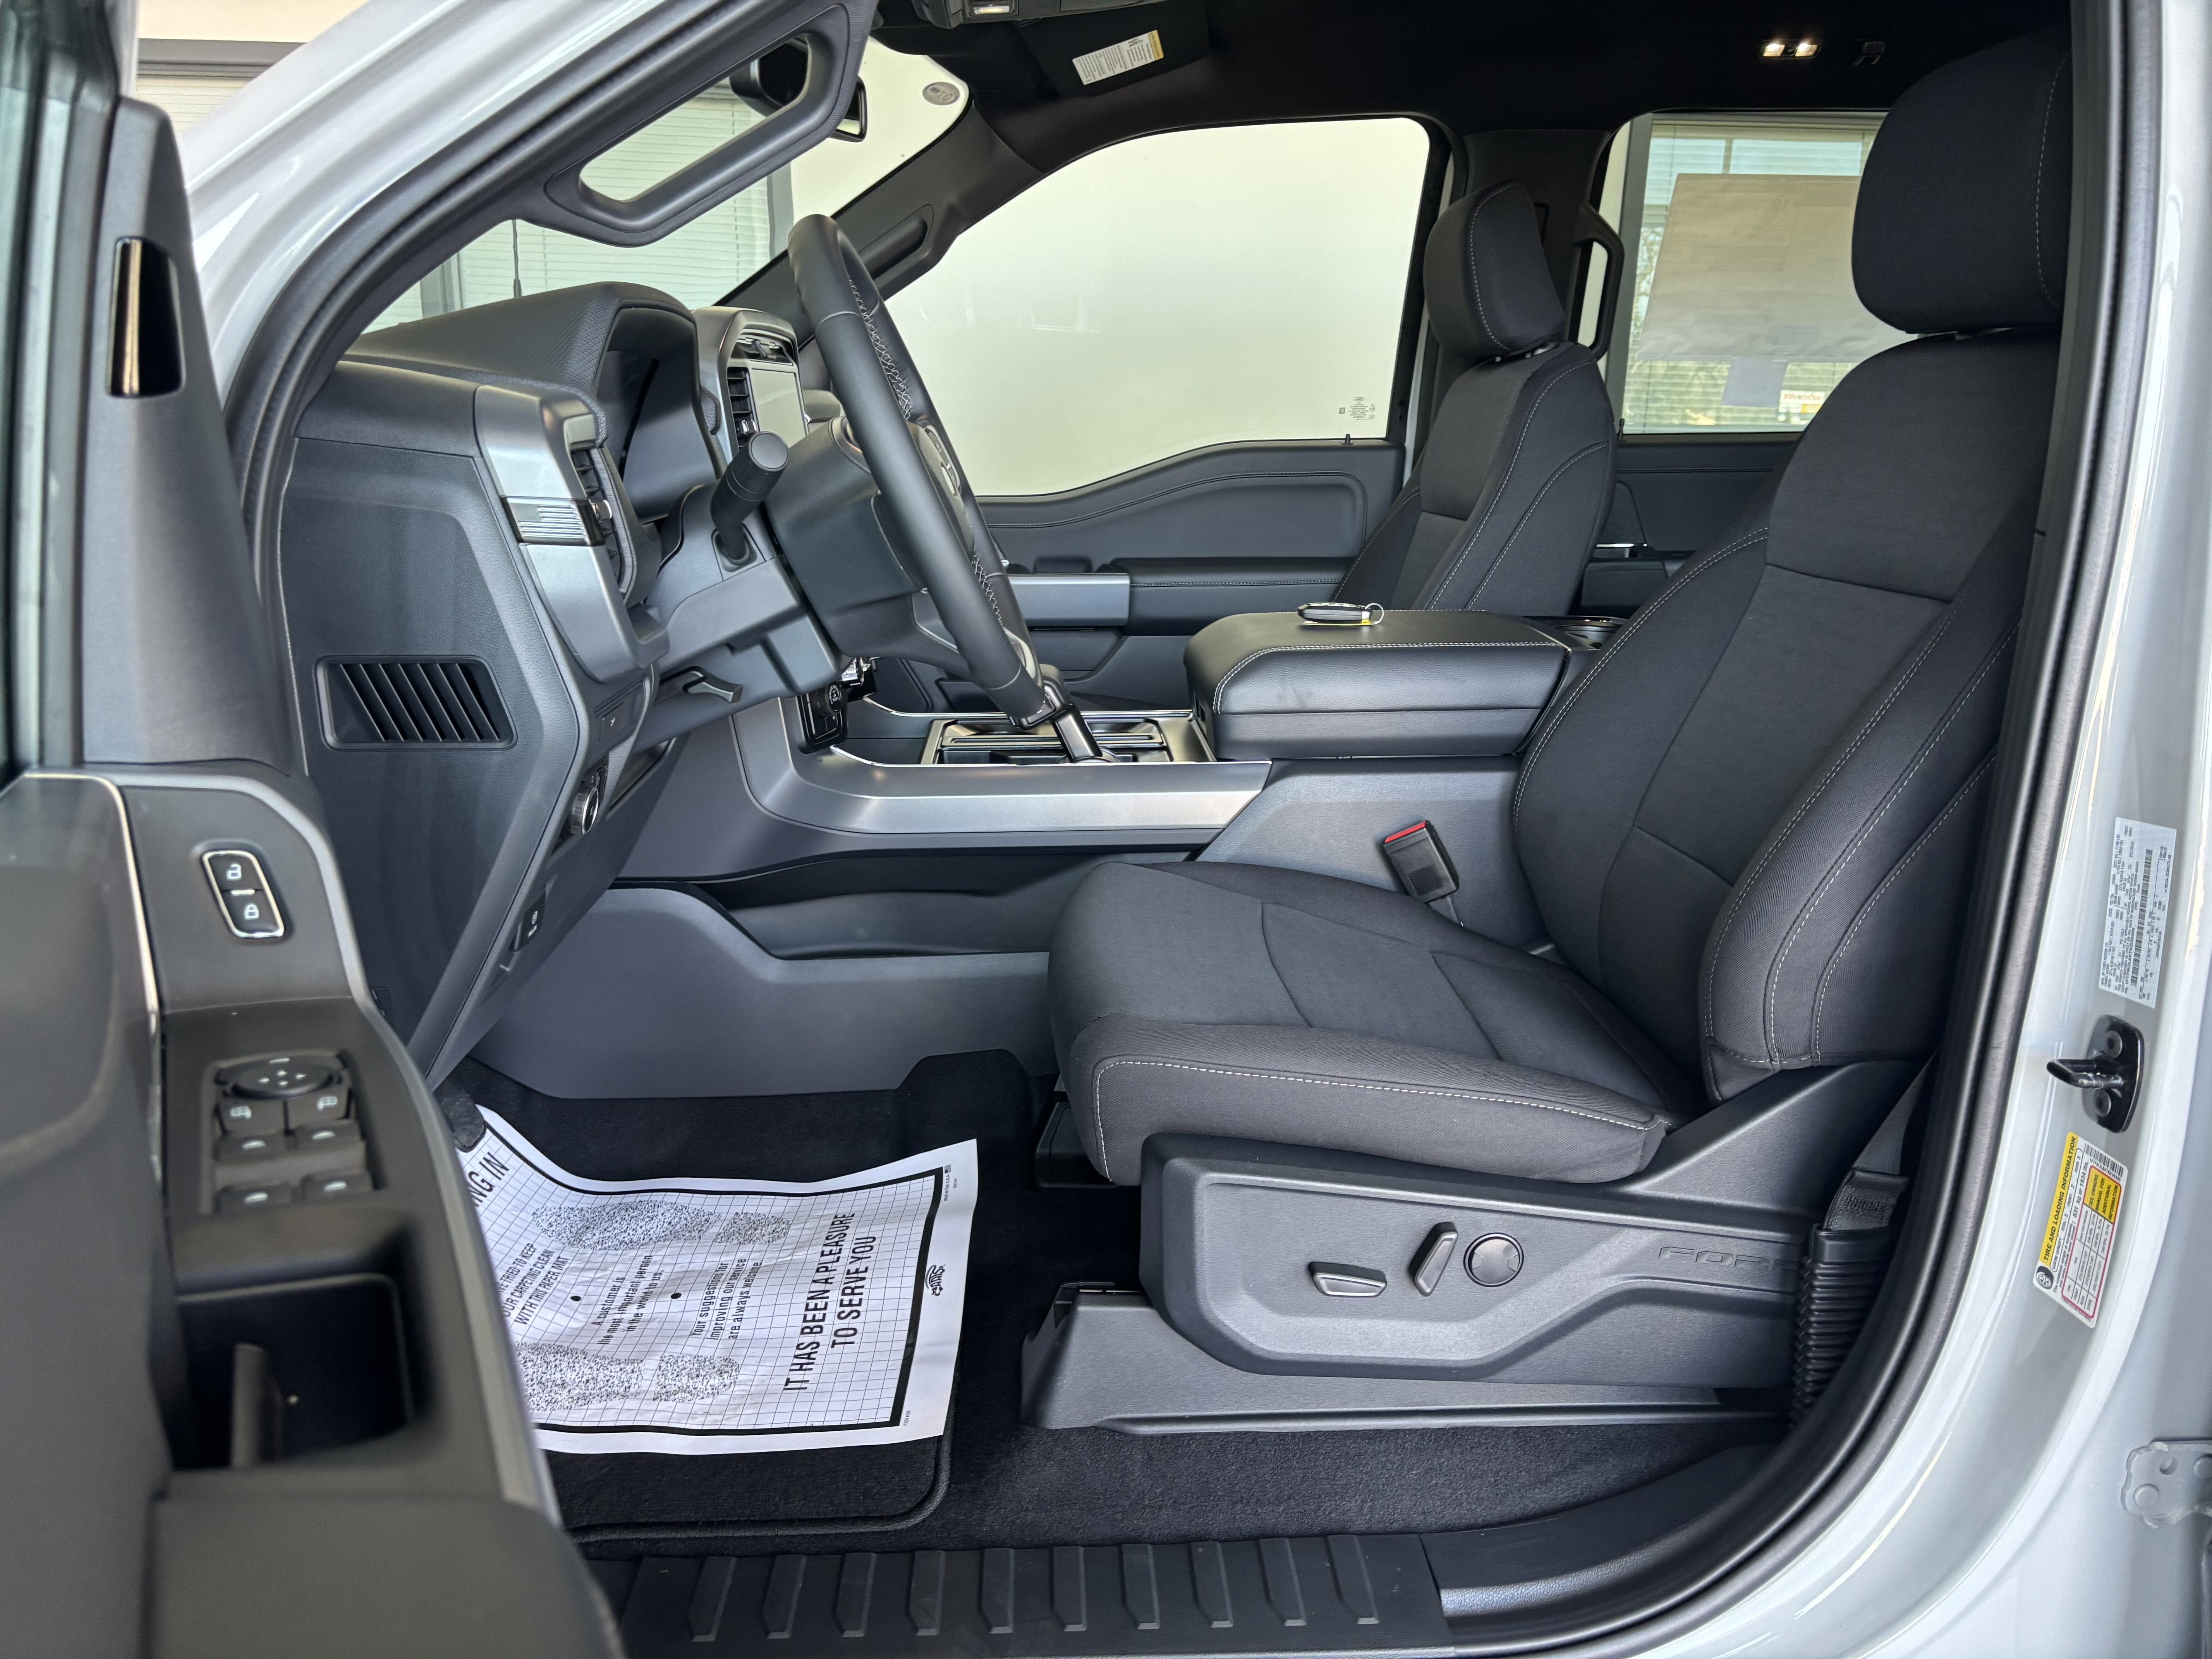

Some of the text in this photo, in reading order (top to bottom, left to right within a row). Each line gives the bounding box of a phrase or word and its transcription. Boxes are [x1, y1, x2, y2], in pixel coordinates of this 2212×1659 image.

[468, 1152, 509, 1207] NG IN
[2044, 1243, 2052, 1261] TIRE
[2053, 1191, 2064, 1225] LOADING
[2061, 1136, 2076, 1190] INFORMATION
[2102, 1184, 2111, 1214] ADDITIONAL
[2109, 1185, 2118, 1221] INFORMATION
[500, 1267, 520, 1283] TRIED
[510, 1268, 541, 1298] CARPETING
[533, 1249, 555, 1269] CLEAN
[513, 1258, 527, 1267] TO
[519, 1243, 537, 1259] KEEP
[514, 1256, 570, 1324] WITH THIS PAPER MAT
[597, 1255, 653, 1344] the most important person
[597, 1285, 621, 1319] customer
[628, 1313, 643, 1324] the
[636, 1291, 653, 1310] world
[651, 1270, 664, 1281] us.
[689, 1263, 729, 1336] Your suggestions for
[706, 1259, 747, 1340] improving our service
[728, 1259, 763, 1339] are always welcome.
[783, 1212, 855, 1391] IT HAS BEEN A PLEASURE
[831, 1236, 877, 1348] TO SERVE YOU
